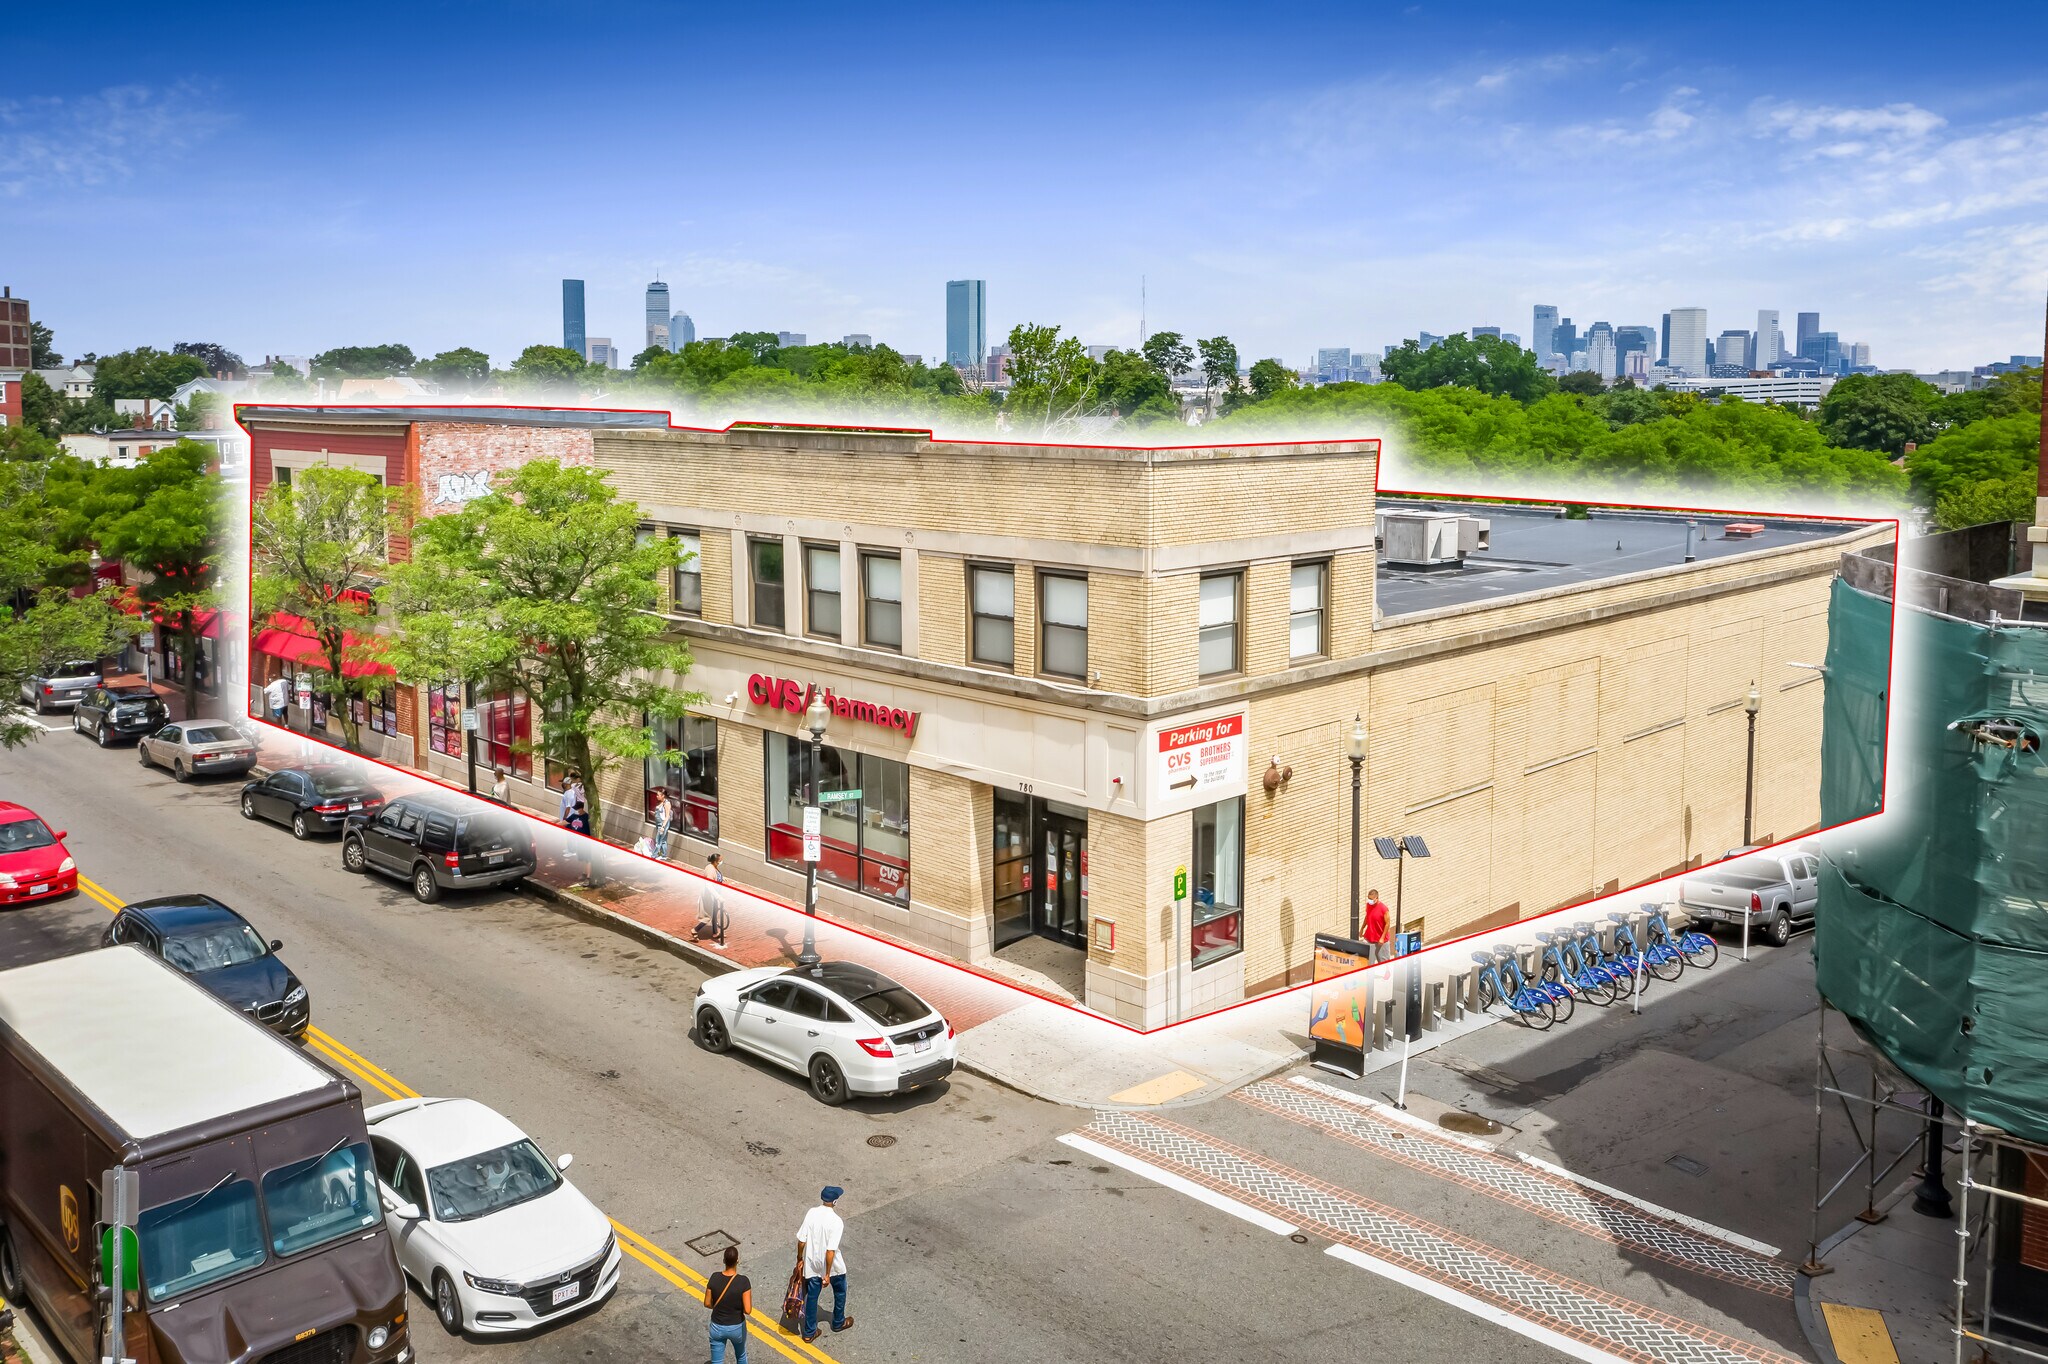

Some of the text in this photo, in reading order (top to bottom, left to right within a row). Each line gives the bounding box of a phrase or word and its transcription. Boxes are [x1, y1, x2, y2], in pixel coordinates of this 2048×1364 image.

[1169, 722, 1232, 747] Parking for
[1200, 741, 1231, 758] BROTHERS
[1168, 752, 1191, 768] CVS
[1200, 752, 1231, 767] SUPERMARKET
[1019, 782, 1034, 793] 780
[826, 792, 847, 800] RAMSEY
[880, 864, 899, 882] CVS
[1178, 877, 1183, 888] P
[1321, 953, 1355, 966] ME TIME
[63, 1205, 78, 1241] ups
